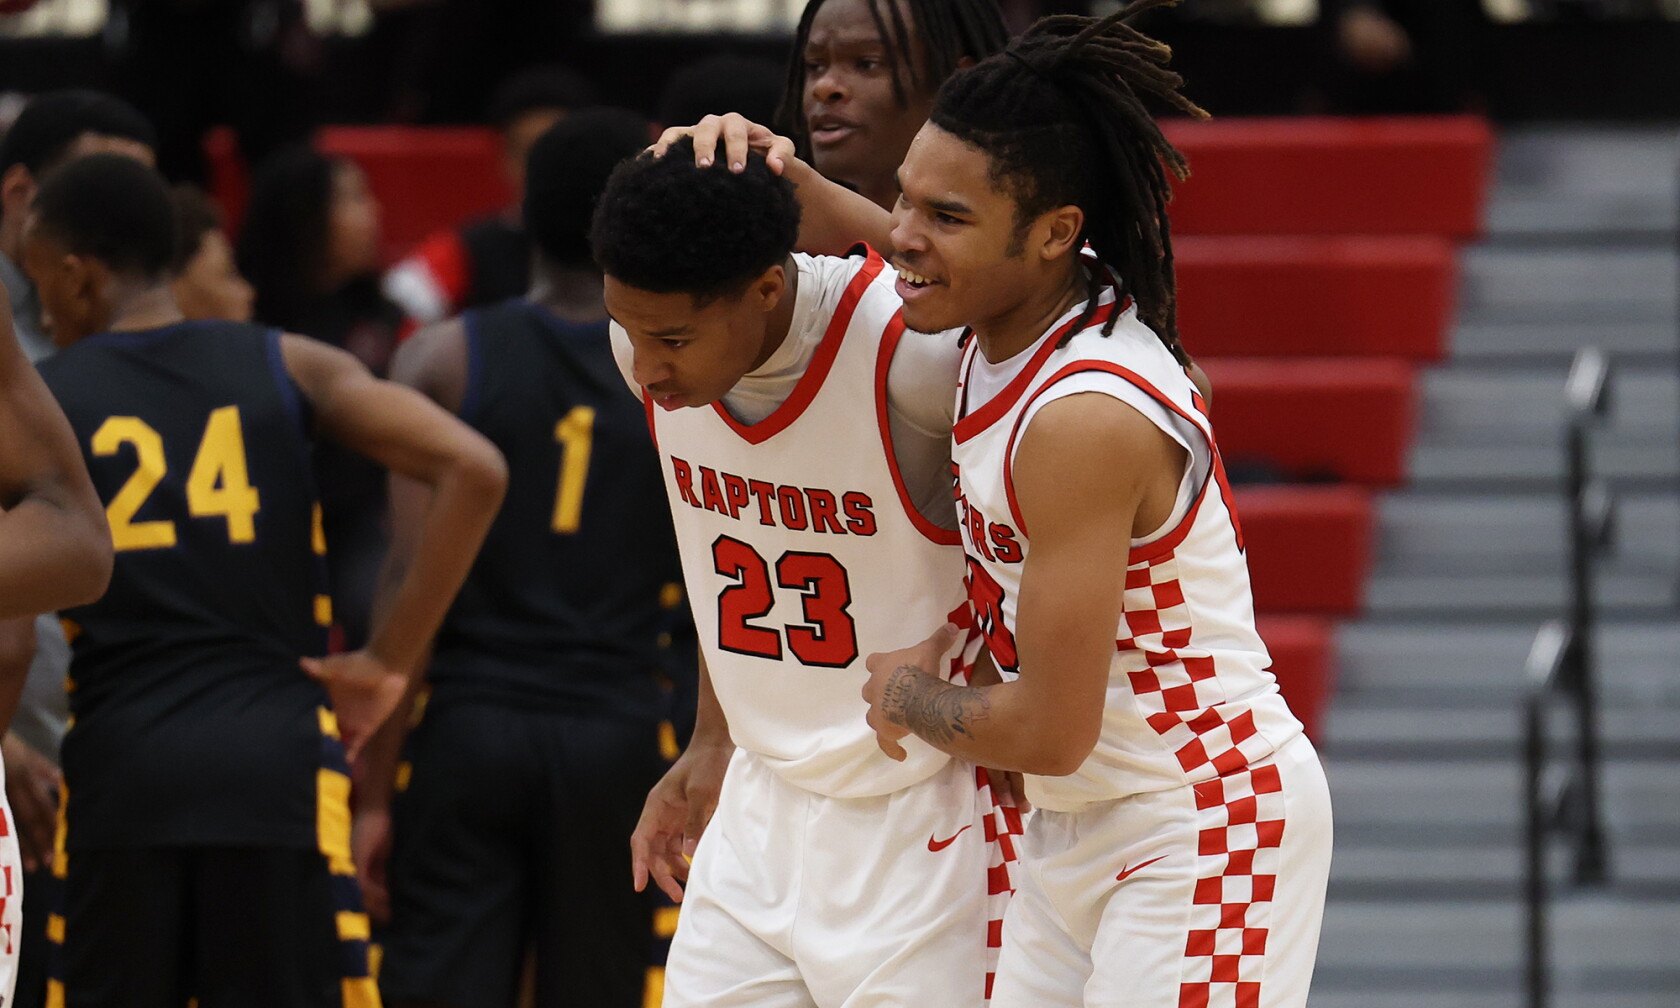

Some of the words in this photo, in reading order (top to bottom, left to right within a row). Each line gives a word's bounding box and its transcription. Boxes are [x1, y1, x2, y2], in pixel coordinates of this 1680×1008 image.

[91, 406, 260, 551] 24
[551, 405, 596, 534] 1
[671, 455, 878, 536] RAPTORS
[711, 534, 859, 669] 23
